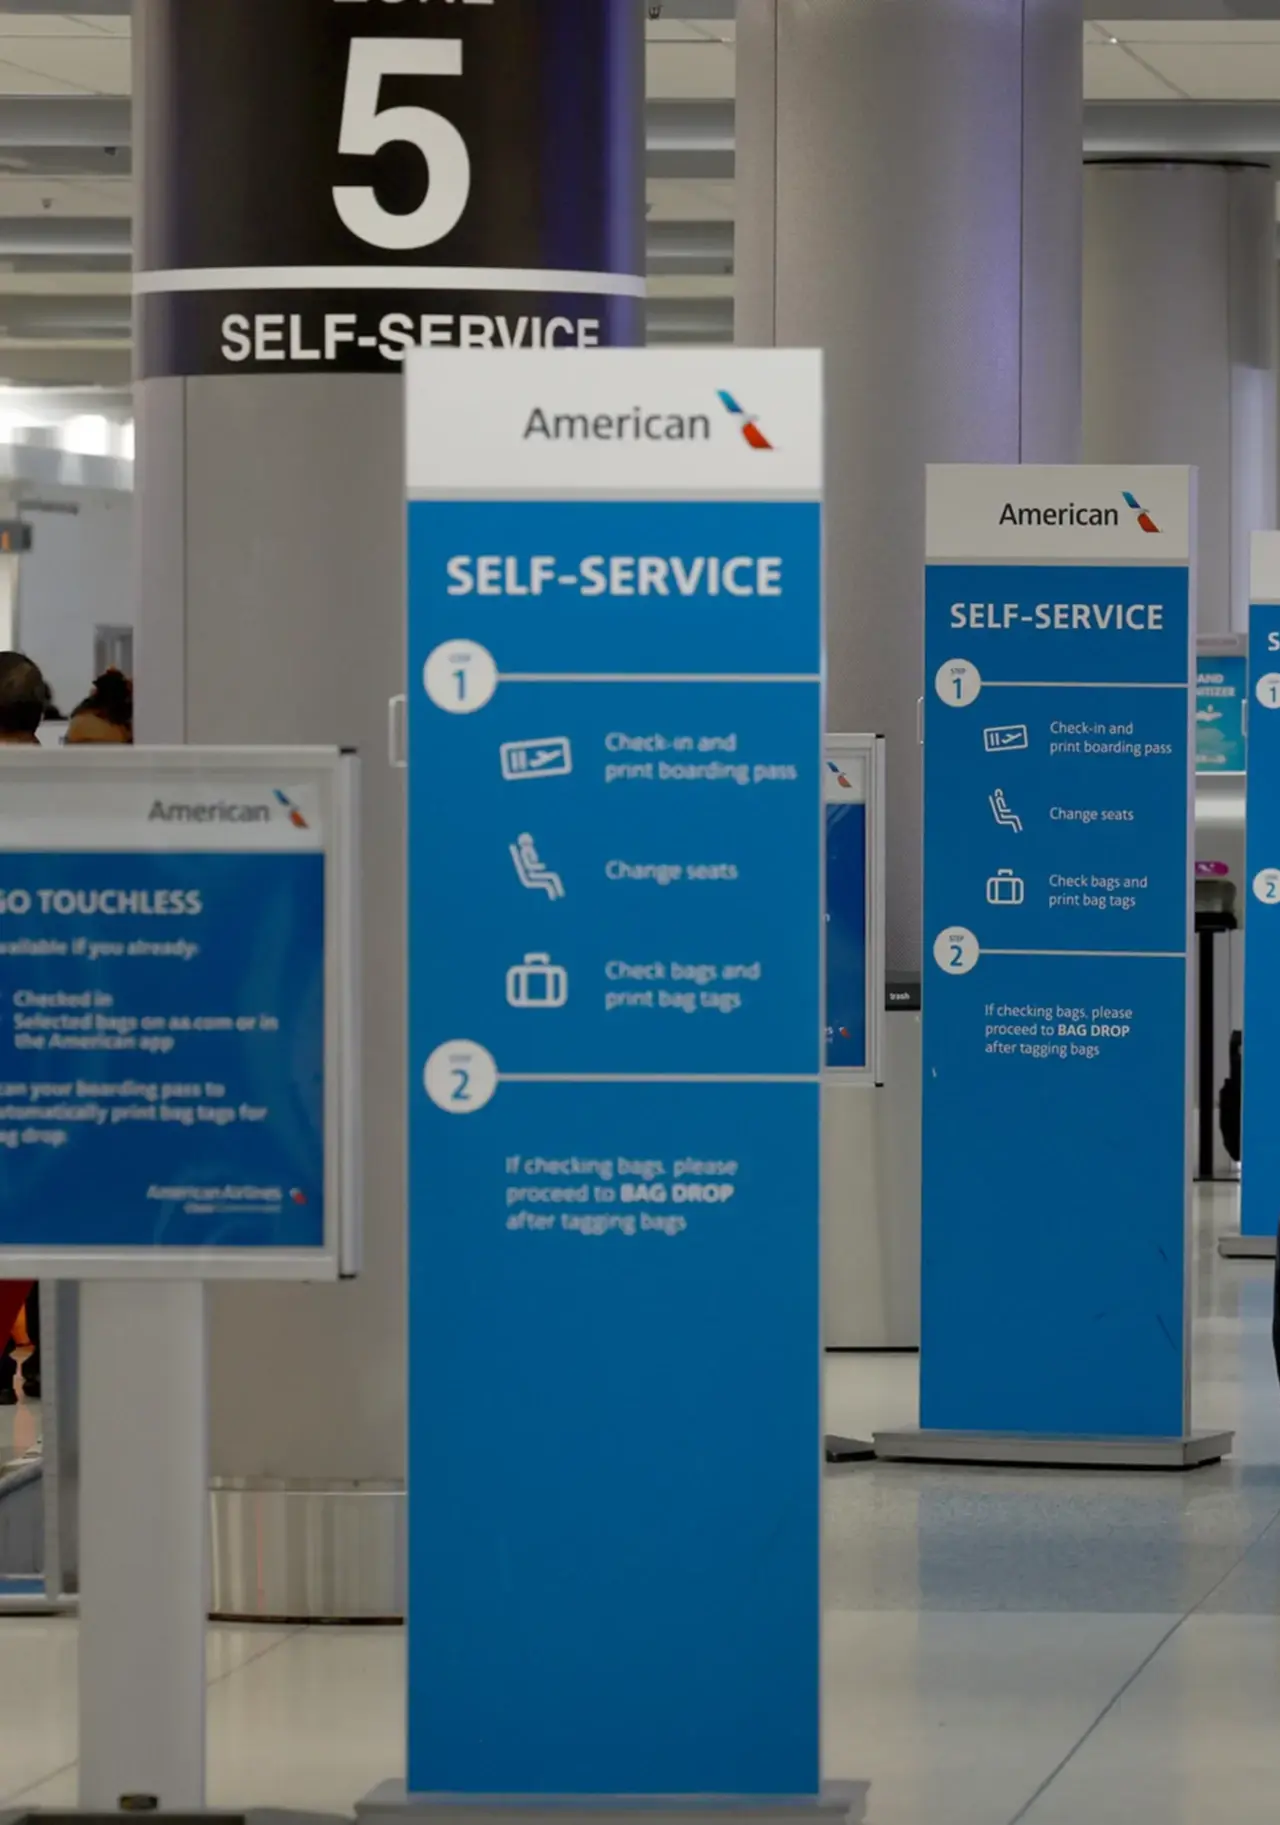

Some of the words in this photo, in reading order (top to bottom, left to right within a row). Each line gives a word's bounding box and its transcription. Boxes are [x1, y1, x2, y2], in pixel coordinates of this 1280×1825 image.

[332, 36, 471, 250] 5
[221, 313, 600, 361] SELF-SERVICE
[522, 406, 711, 440] American
[999, 503, 1118, 526] American
[446, 555, 782, 597] SELF-SERVICE
[950, 603, 1163, 630] SELF-SERVICE
[451, 669, 464, 701] 1
[952, 677, 962, 700] 1
[1269, 686, 1276, 703] 1
[1050, 722, 1106, 736] Check-in
[1109, 722, 1133, 736] and
[605, 732, 694, 752] Check-in
[698, 732, 738, 752] and
[1050, 741, 1080, 756] print
[1084, 741, 1141, 757] boarding
[1144, 743, 1172, 757] pass
[605, 762, 653, 784] print
[658, 761, 750, 785] boarding
[754, 764, 798, 784] pass
[148, 800, 270, 824] American
[1050, 807, 1098, 823] Change
[1101, 808, 1134, 821] seats
[605, 860, 682, 886] Change
[686, 863, 738, 880] seats
[1049, 875, 1088, 888] Check
[1091, 875, 1120, 891] bags
[1123, 876, 1148, 889] and
[37, 888, 203, 915] TOUCHLESS
[1266, 882, 1276, 898] 2
[1049, 894, 1080, 908] print
[1083, 894, 1106, 910] bag
[1110, 895, 1136, 910] tags
[89, 941, 125, 961] you
[950, 945, 963, 967] 2
[605, 961, 665, 981] Check
[670, 961, 716, 984] bags
[722, 961, 760, 981] and
[13, 989, 92, 1008] Checked
[605, 990, 653, 1011] print
[658, 990, 696, 1013] bag
[700, 991, 741, 1013] tags
[889, 992, 910, 1001] trash
[985, 1004, 995, 1016] If
[997, 1005, 1053, 1021] checking
[1091, 1006, 1133, 1021] please
[48, 1033, 137, 1050] American
[985, 1024, 1037, 1038] proceed
[1041, 1025, 1054, 1036] to
[1058, 1024, 1087, 1037] BAG
[1091, 1025, 1130, 1037] DROP
[985, 1040, 1017, 1054] after
[1020, 1042, 1067, 1058] tagging
[1070, 1042, 1100, 1058] bags
[450, 1069, 470, 1101] 2
[505, 1155, 520, 1175] If
[524, 1156, 613, 1181] checking
[673, 1156, 739, 1179] please
[506, 1184, 589, 1207] proceed
[594, 1186, 616, 1203] to
[620, 1183, 667, 1204] BAG
[671, 1184, 735, 1204] DROP
[506, 1210, 555, 1231] after
[561, 1211, 637, 1236] tagging
[640, 1211, 687, 1236] bags
